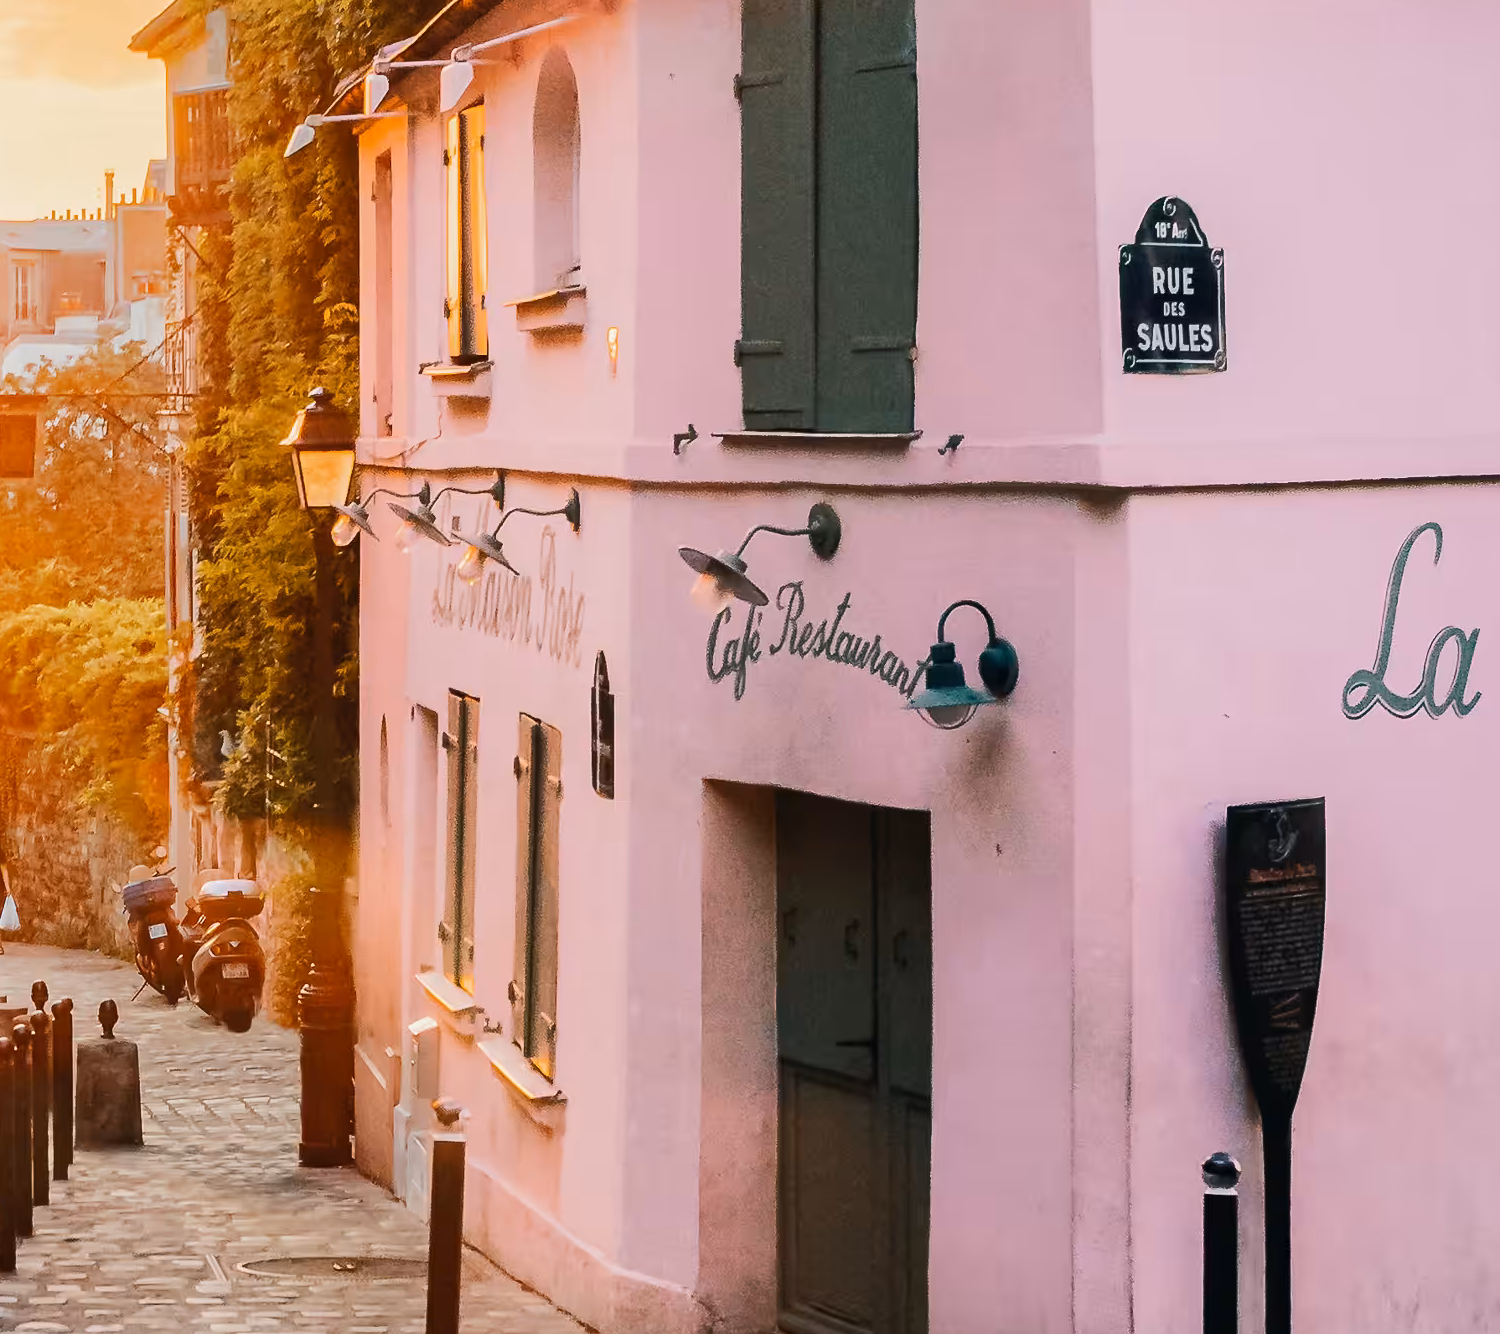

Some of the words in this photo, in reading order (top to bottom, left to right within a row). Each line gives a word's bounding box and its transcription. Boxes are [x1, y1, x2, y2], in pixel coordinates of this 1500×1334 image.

[1152, 266, 1195, 295] RUE
[1163, 301, 1186, 317] DES
[1137, 322, 1214, 352] SAULES
[1342, 521, 1483, 720] La
[706, 604, 763, 701] Café
[769, 580, 931, 698] Restaurant
